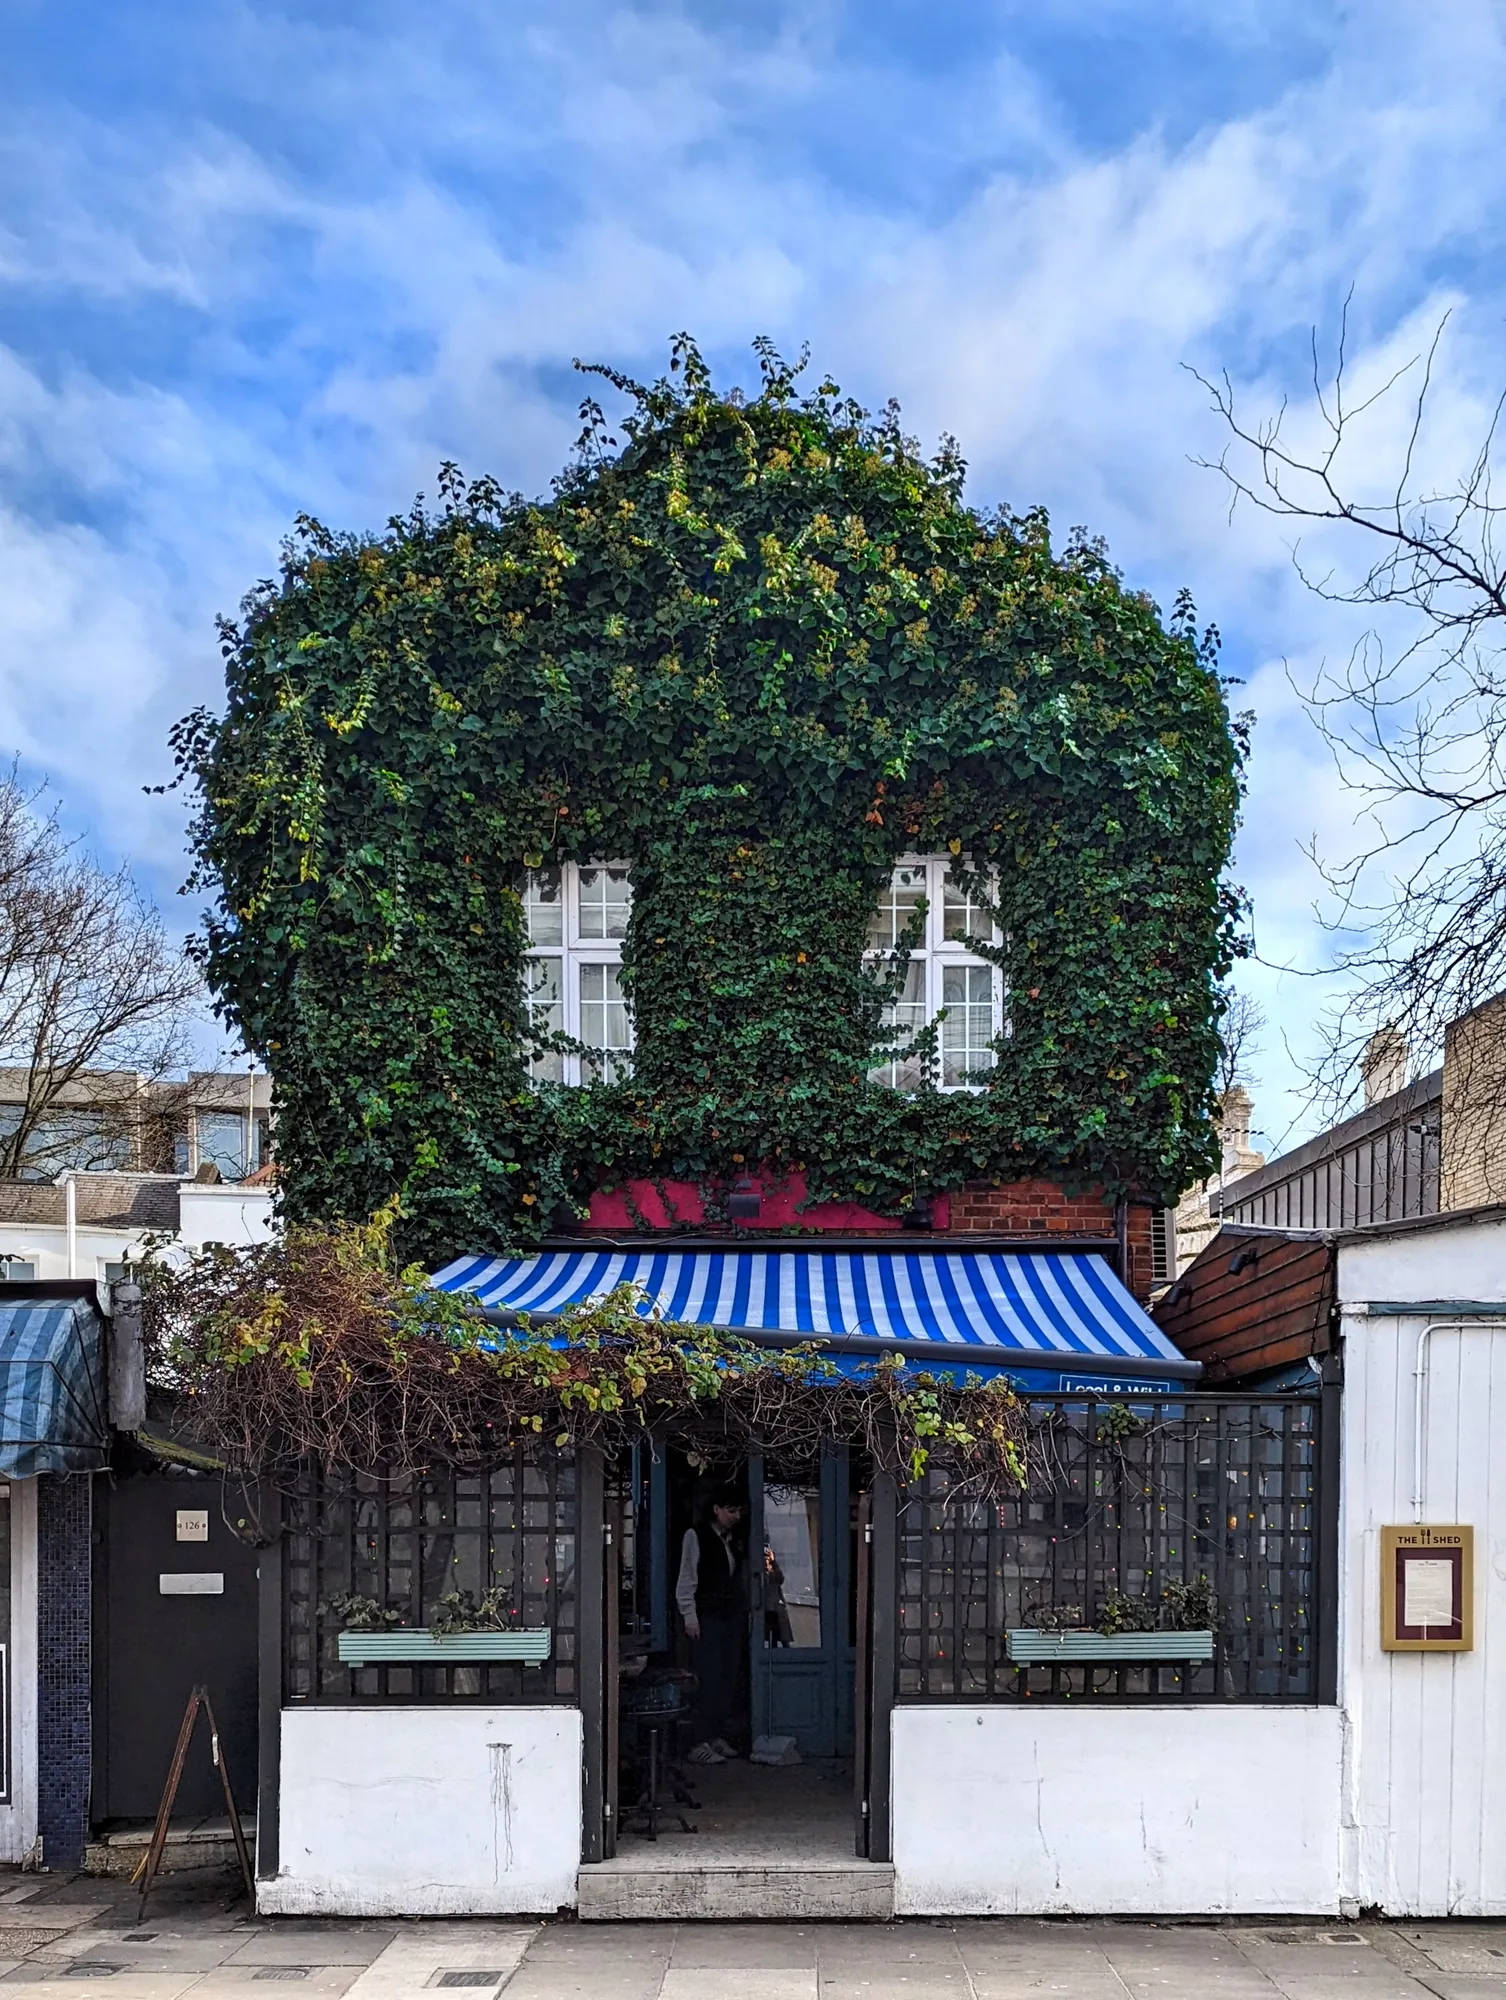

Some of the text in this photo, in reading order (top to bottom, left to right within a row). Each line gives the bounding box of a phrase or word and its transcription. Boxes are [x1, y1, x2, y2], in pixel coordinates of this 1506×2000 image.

[185, 1521, 200, 1530] 126
[1398, 1536, 1461, 1544] THE SHED
